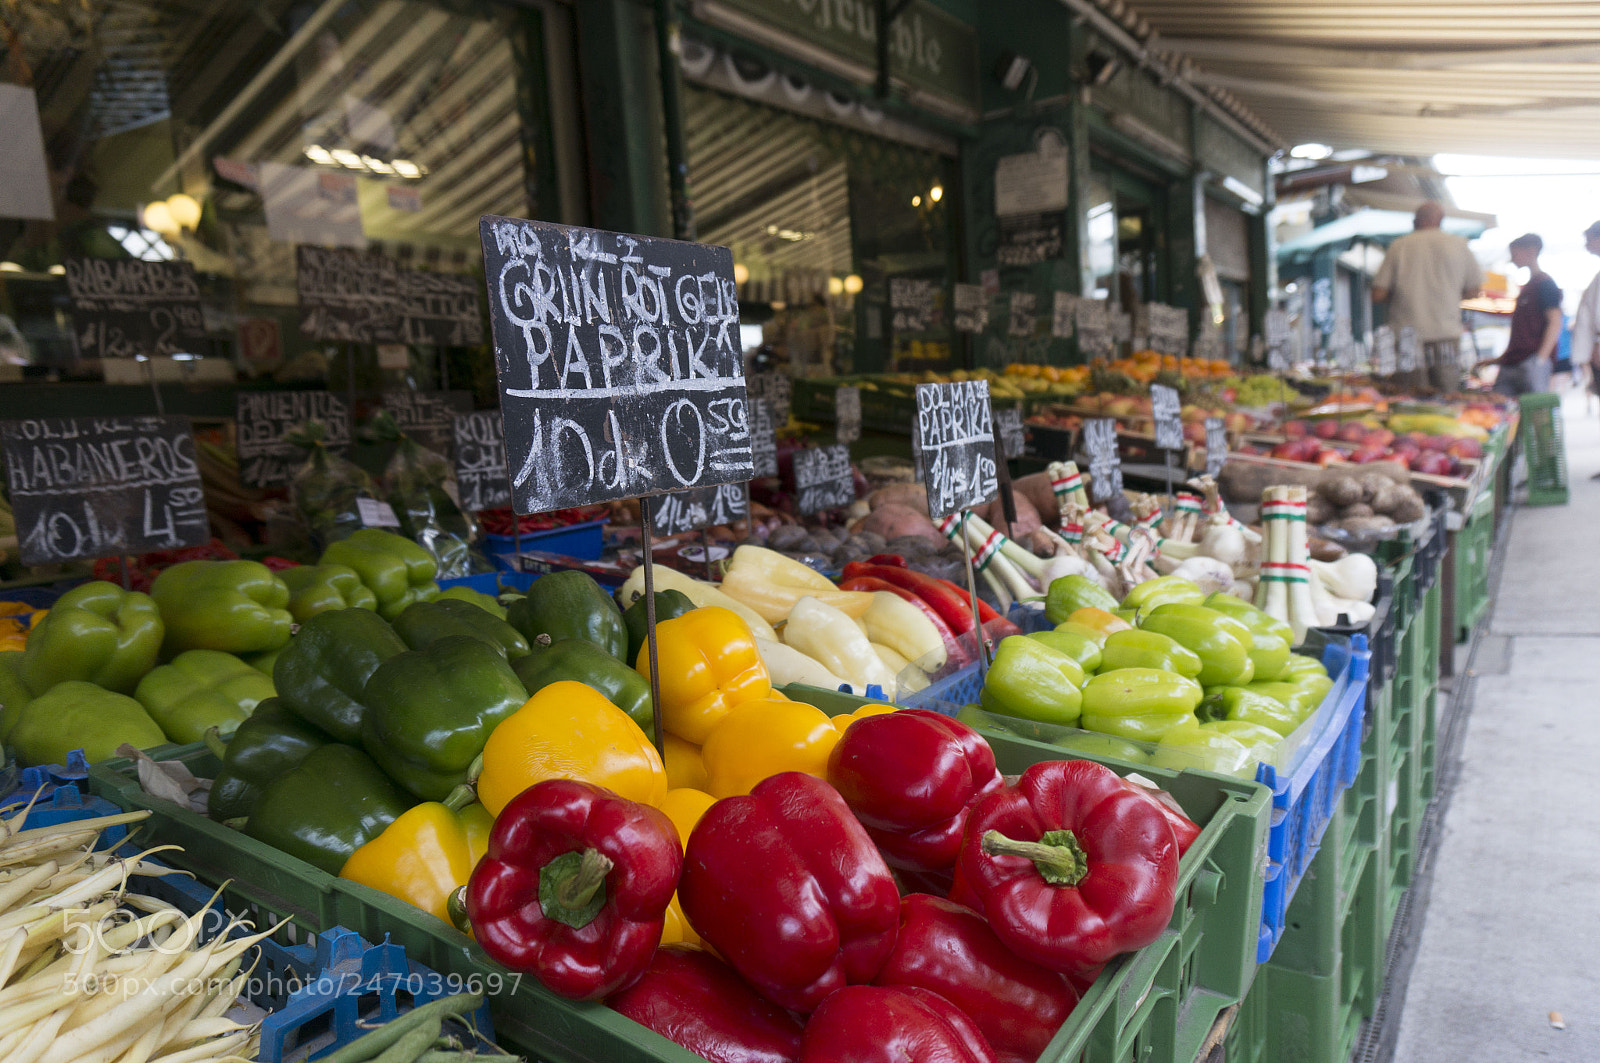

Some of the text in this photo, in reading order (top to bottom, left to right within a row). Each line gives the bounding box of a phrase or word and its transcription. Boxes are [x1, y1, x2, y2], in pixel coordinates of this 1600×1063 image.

[622, 263, 671, 327] ROT
[523, 318, 742, 389] PAPRIKA
[920, 399, 994, 447] PAPRIKA
[6, 433, 198, 491] HABANEROS
